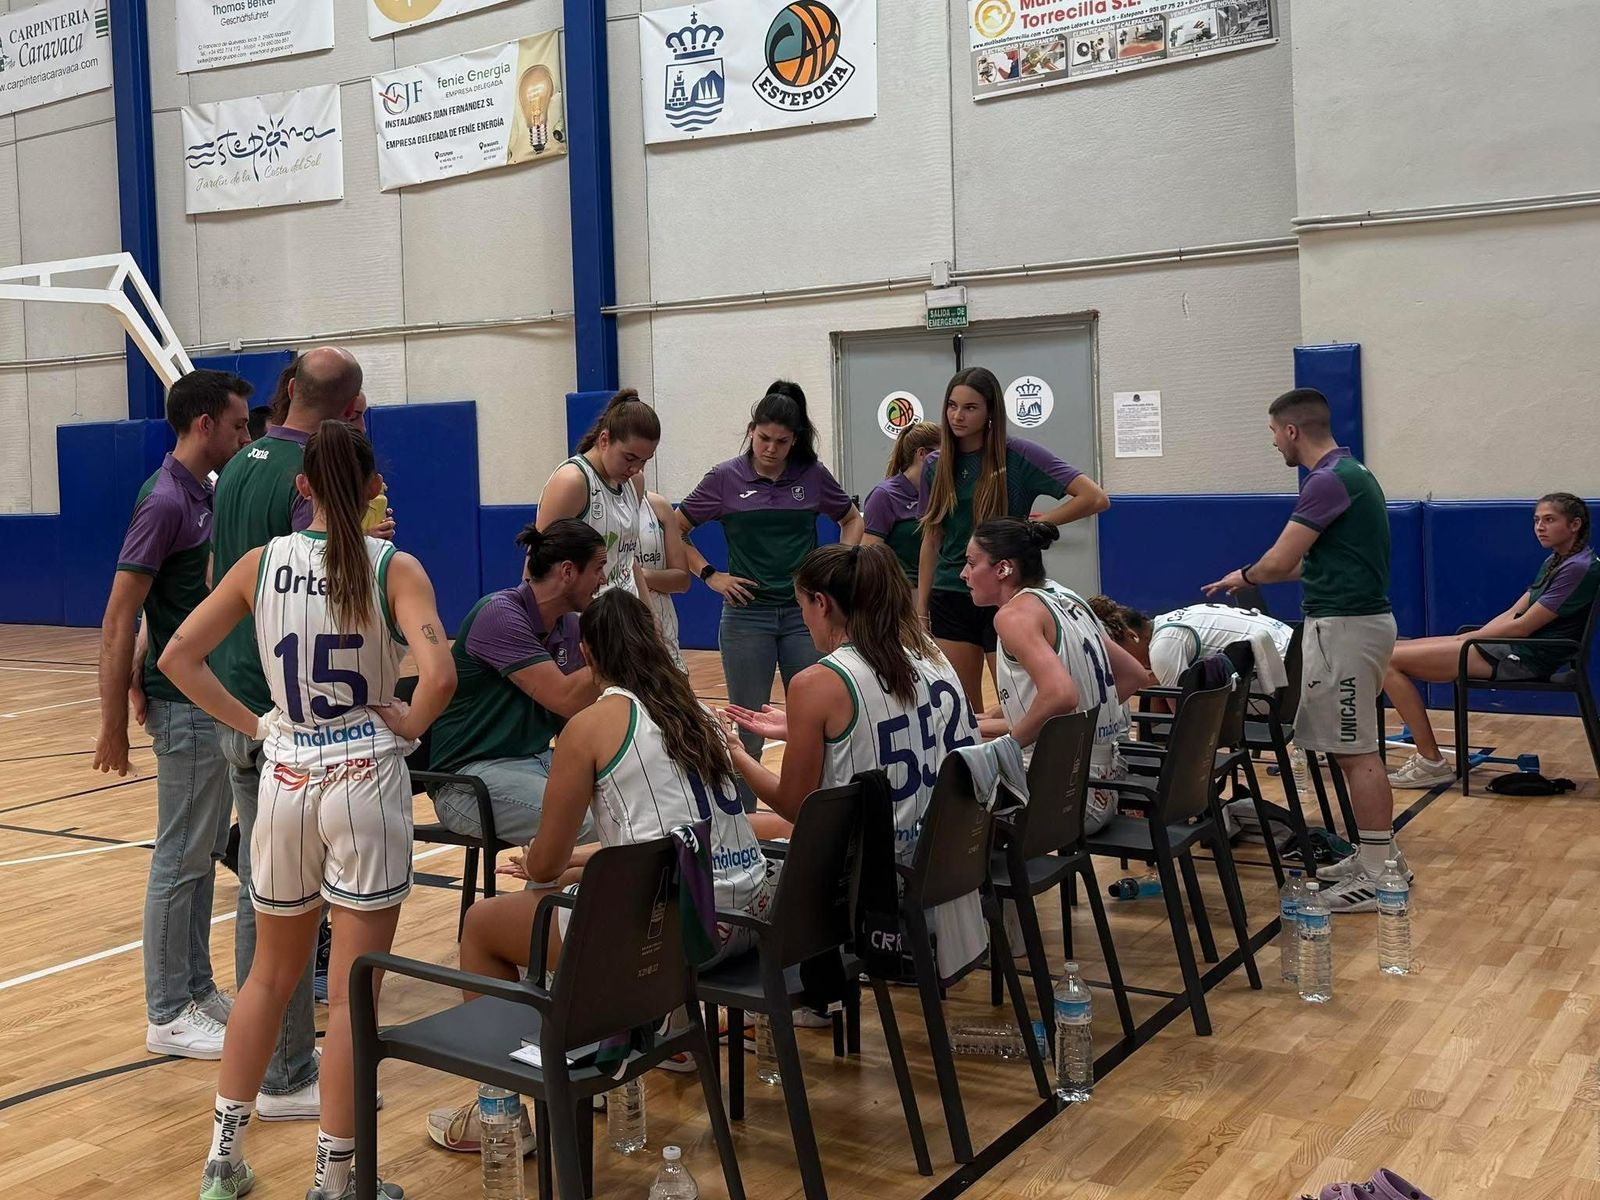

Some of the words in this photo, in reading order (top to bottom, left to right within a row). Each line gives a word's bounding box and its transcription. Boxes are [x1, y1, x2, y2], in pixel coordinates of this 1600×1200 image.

[212, 0, 245, 15] Thomas
[1020, 0, 1107, 29] Torrecilla
[9, 8, 90, 44] CARPINTERIA
[18, 33, 83, 68] Caravaca
[445, 87, 473, 99] EMPRESA
[474, 79, 504, 92] DELEGADA
[758, 65, 849, 107] ESTEPONA
[385, 111, 433, 129] INSTALACIONES
[433, 108, 448, 120] JUAN
[486, 97, 495, 107] SL
[385, 137, 417, 150] EMPRESA
[417, 130, 449, 145] DELEGADA
[449, 127, 458, 139] DE
[928, 316, 967, 328] EMERGENCIA
[930, 308, 951, 318] SALIDA
[956, 307, 965, 316] DE
[274, 632, 368, 724] 15
[1340, 677, 1357, 743] UNICAJA
[217, 1113, 240, 1157] UNICAJA
